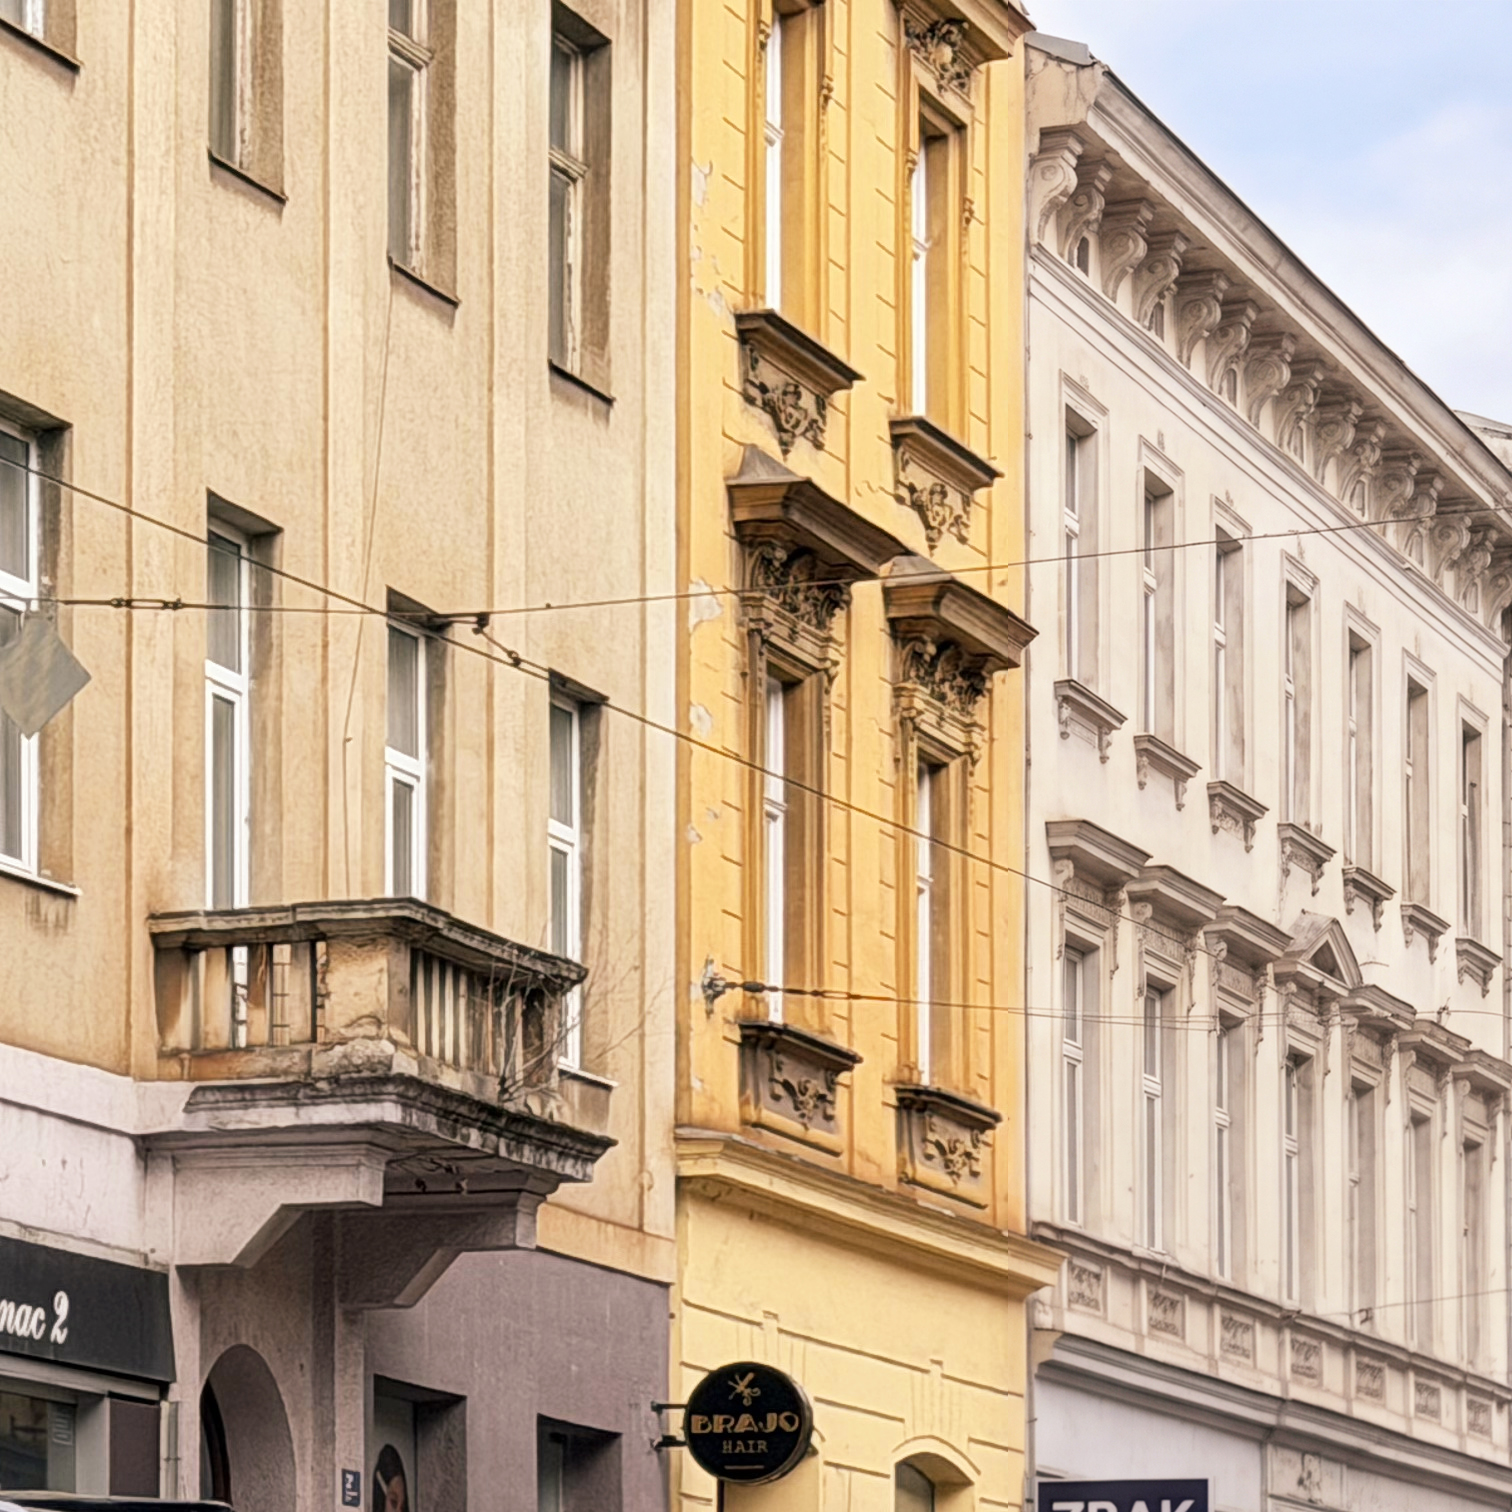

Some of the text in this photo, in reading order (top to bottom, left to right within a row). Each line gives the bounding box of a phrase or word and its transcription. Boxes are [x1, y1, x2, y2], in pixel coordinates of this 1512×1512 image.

[49, 1290, 70, 1344] 2
[690, 1411, 799, 1434] BRAJO
[721, 1440, 769, 1454] HAIR
